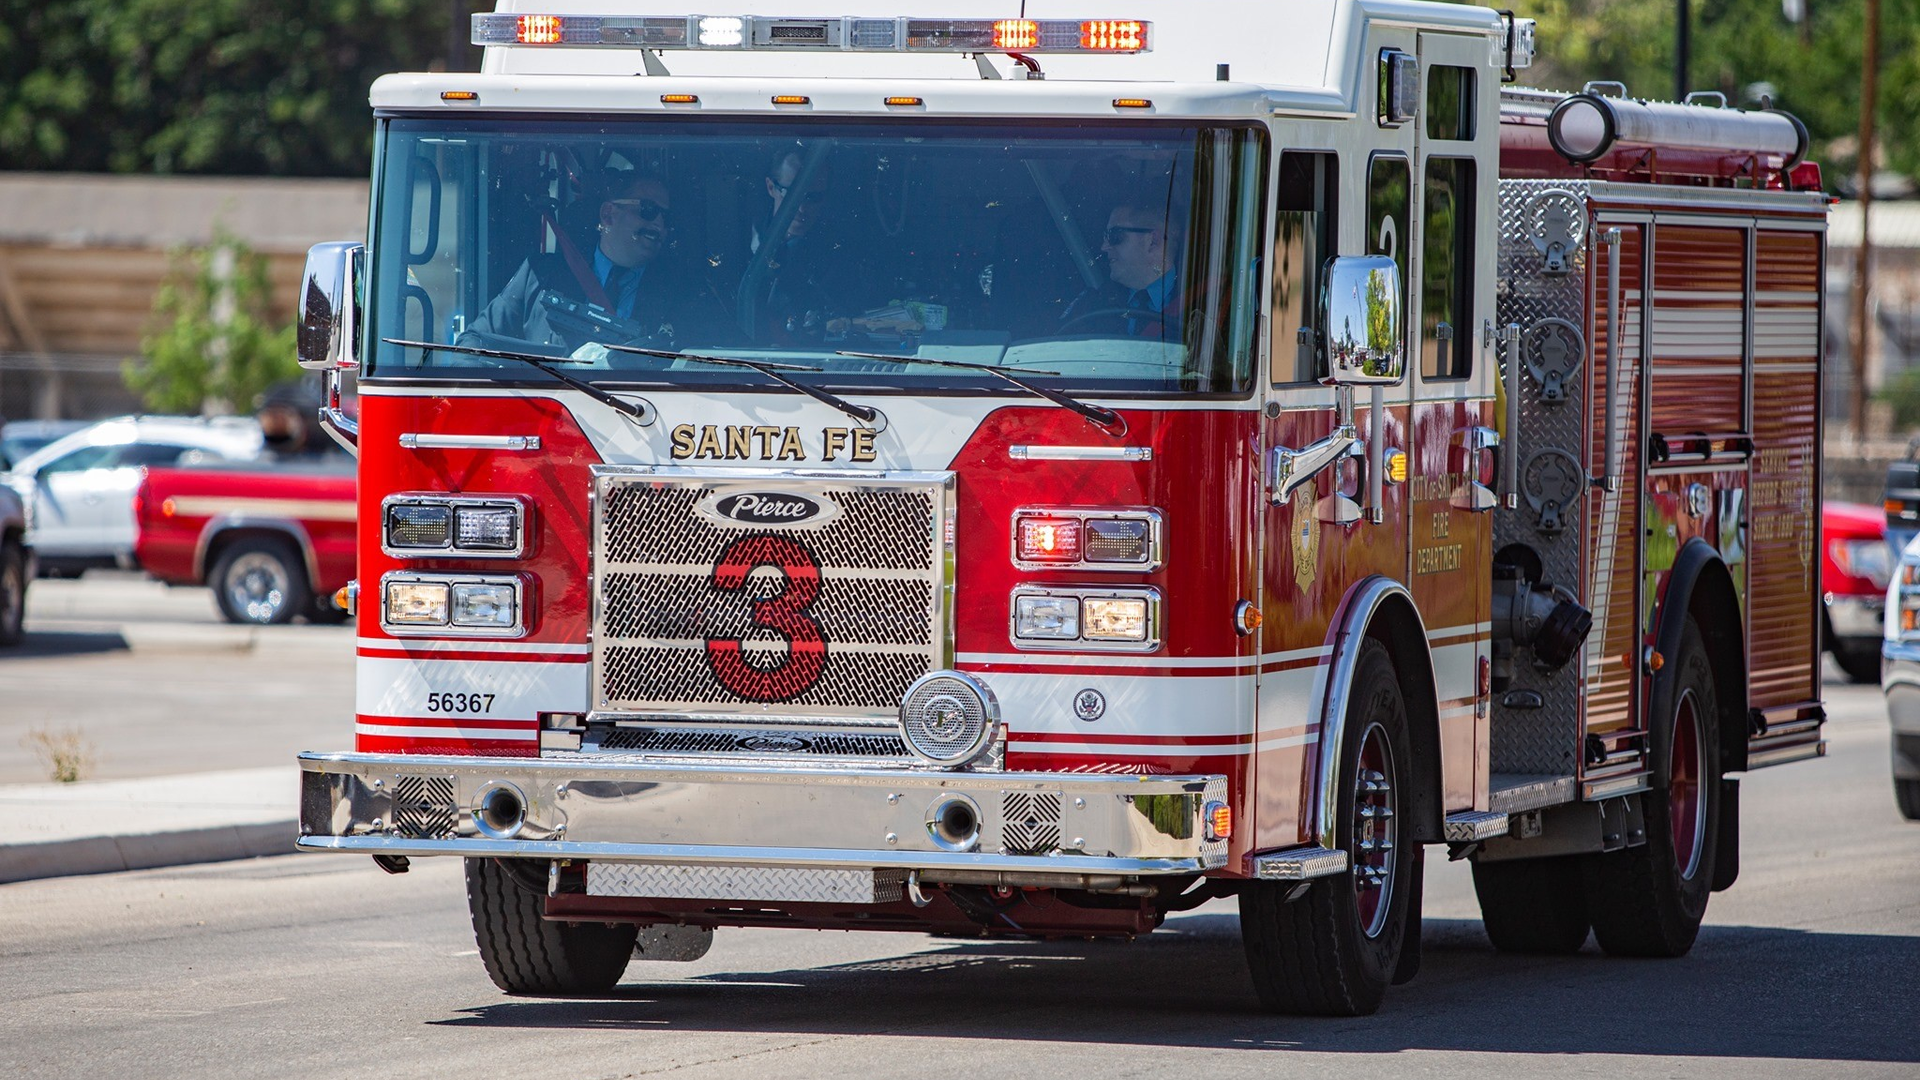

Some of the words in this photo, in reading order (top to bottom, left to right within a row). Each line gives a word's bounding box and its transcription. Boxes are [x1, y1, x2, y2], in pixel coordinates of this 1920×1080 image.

[671, 424, 806, 460] SANTA
[822, 427, 877, 462] FE
[1413, 474, 1429, 501] CITY
[730, 494, 807, 518] Pierce
[1433, 512, 1449, 538] FIRE
[1417, 544, 1462, 575] DEPARTMENT
[705, 533, 829, 703] 3
[428, 692, 496, 713] 56367
